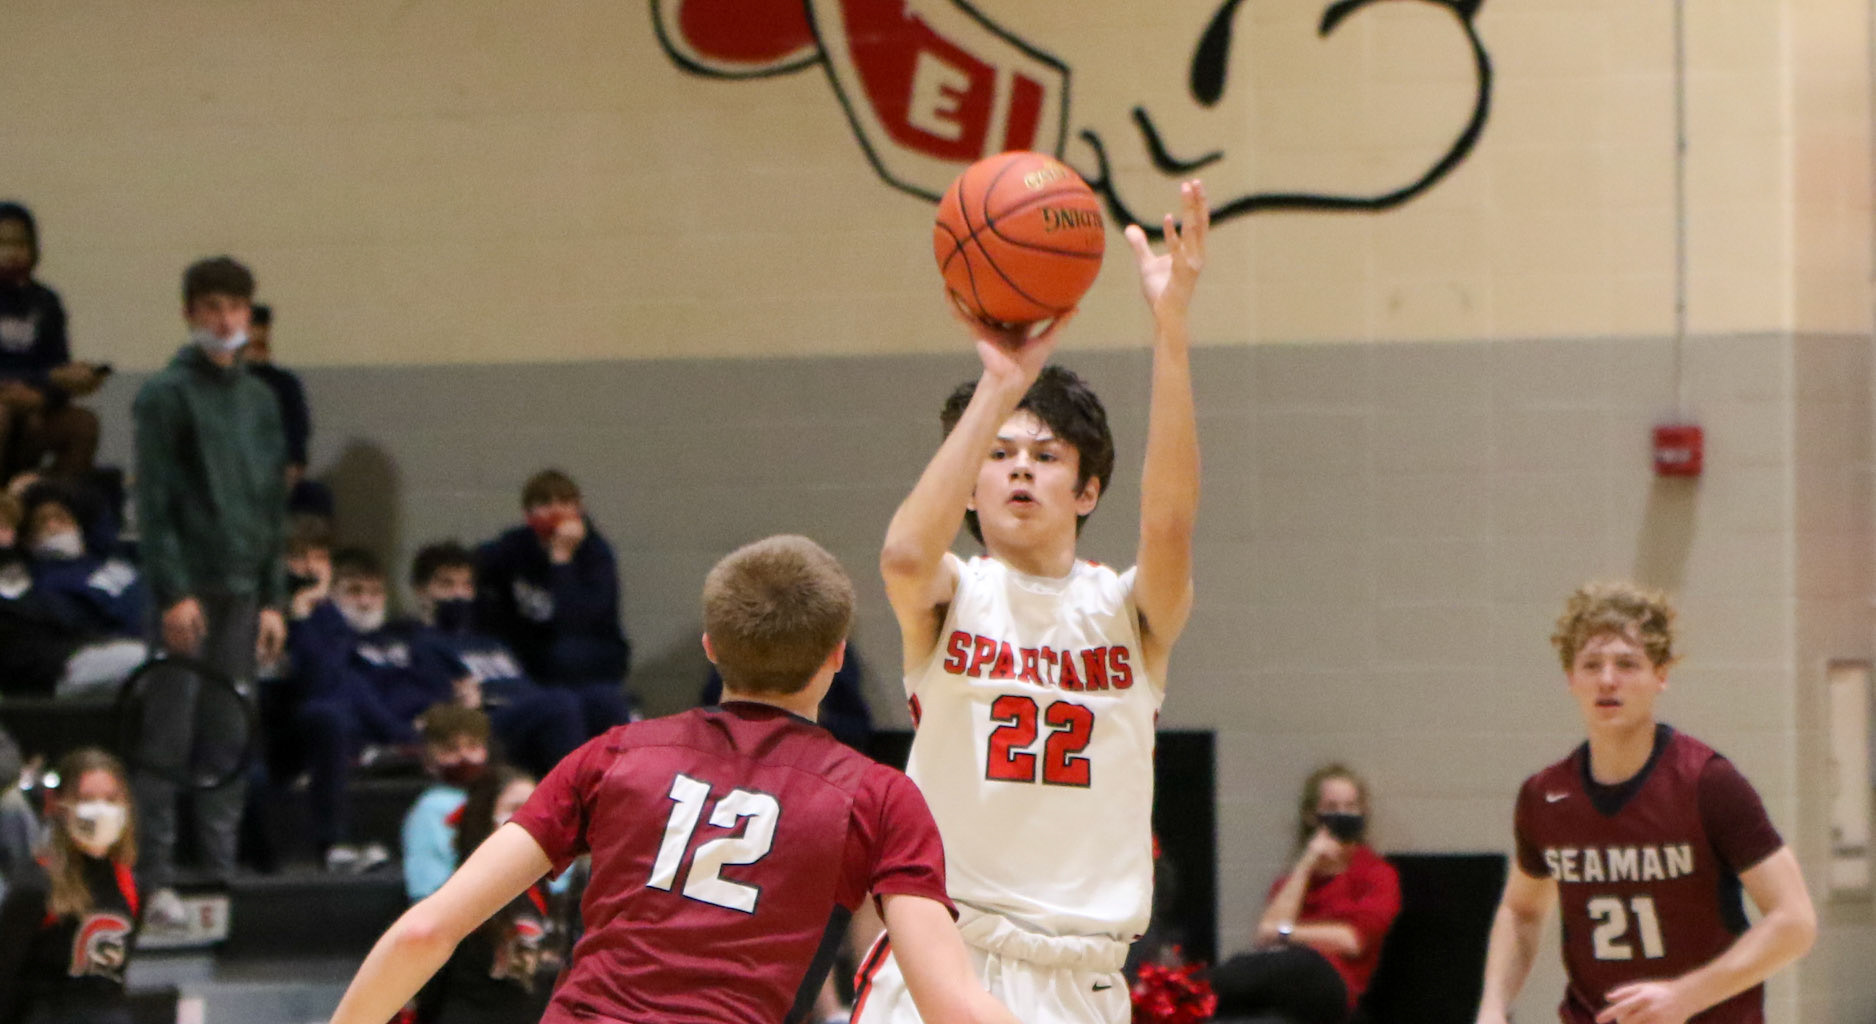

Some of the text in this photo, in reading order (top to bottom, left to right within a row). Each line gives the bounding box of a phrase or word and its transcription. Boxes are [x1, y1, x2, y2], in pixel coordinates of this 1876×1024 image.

[944, 630, 1134, 692] SPARTANS
[985, 694, 1095, 788] 22
[646, 773, 782, 915] 12
[1544, 842, 1695, 883] SEAMAN
[1586, 896, 1665, 960] 21
